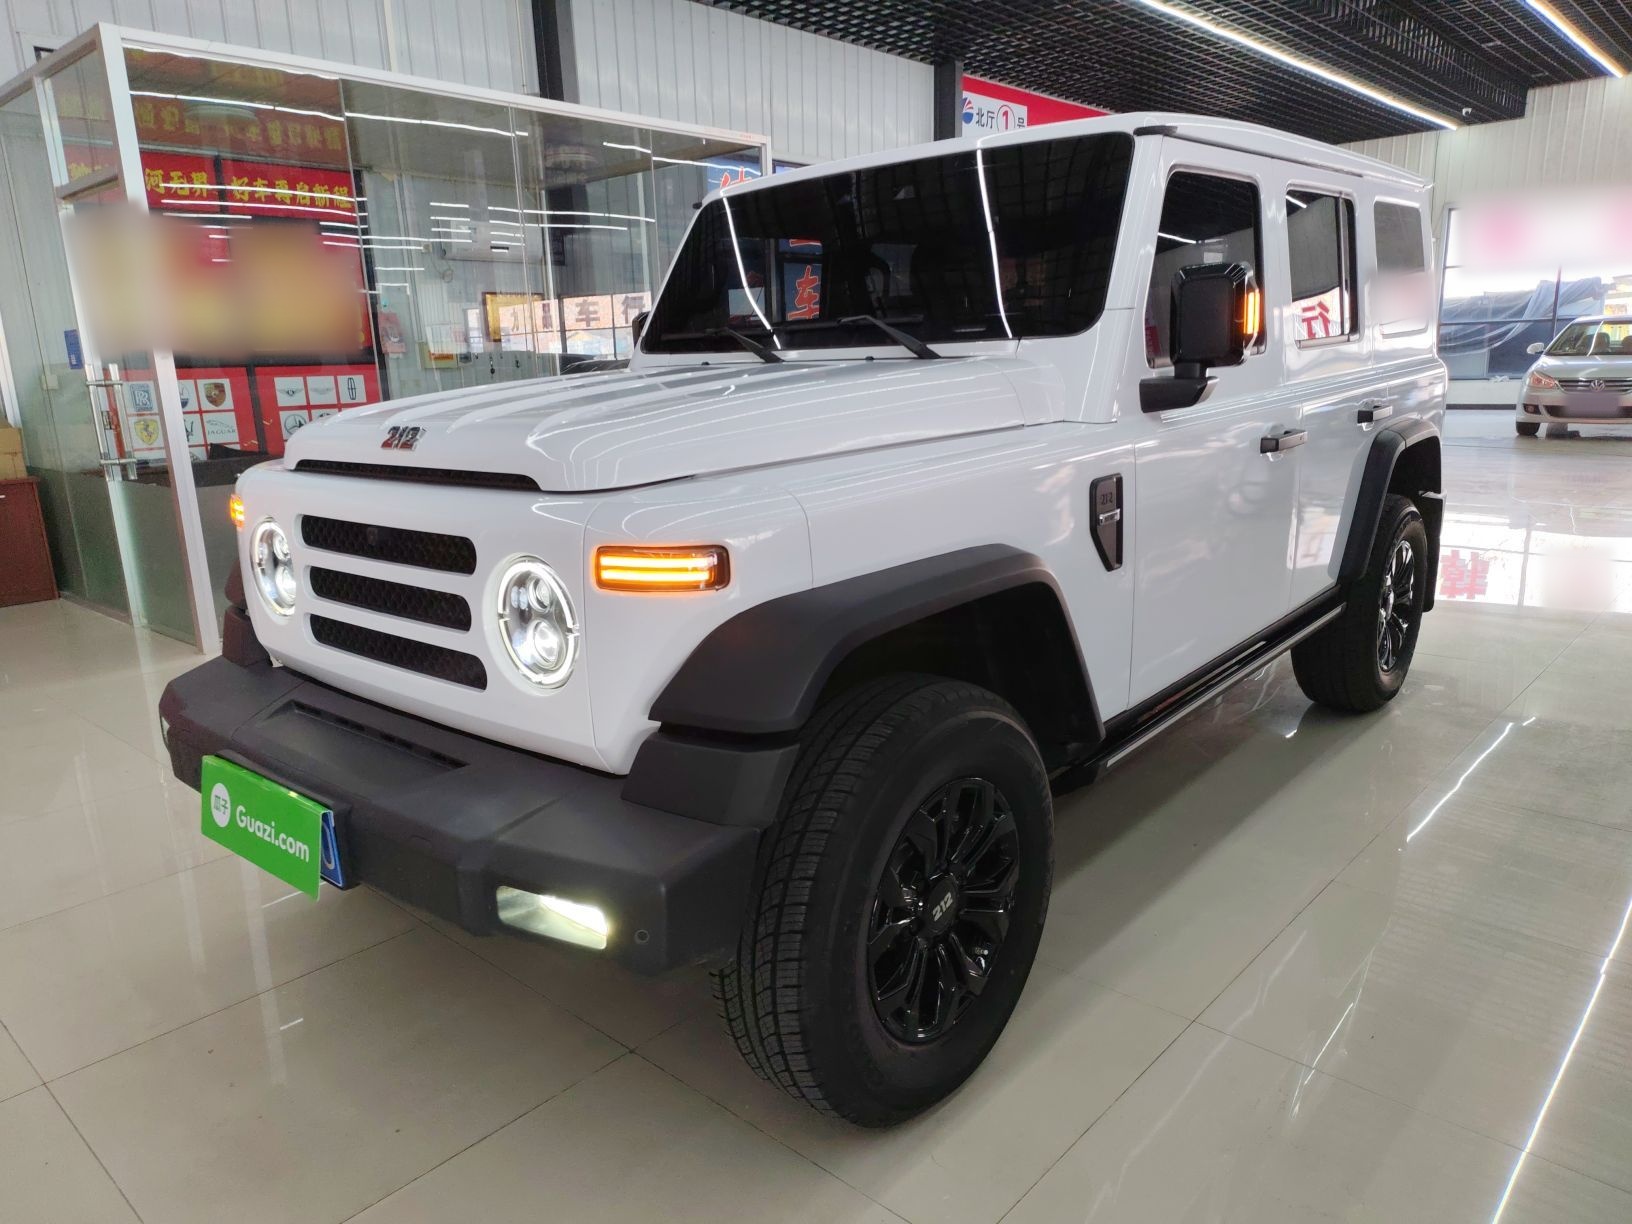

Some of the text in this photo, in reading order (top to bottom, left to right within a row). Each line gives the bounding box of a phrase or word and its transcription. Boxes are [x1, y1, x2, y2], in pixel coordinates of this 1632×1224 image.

[380, 425, 422, 449] 212
[236, 805, 309, 863] Guazi.com
[932, 891, 953, 921] 212
